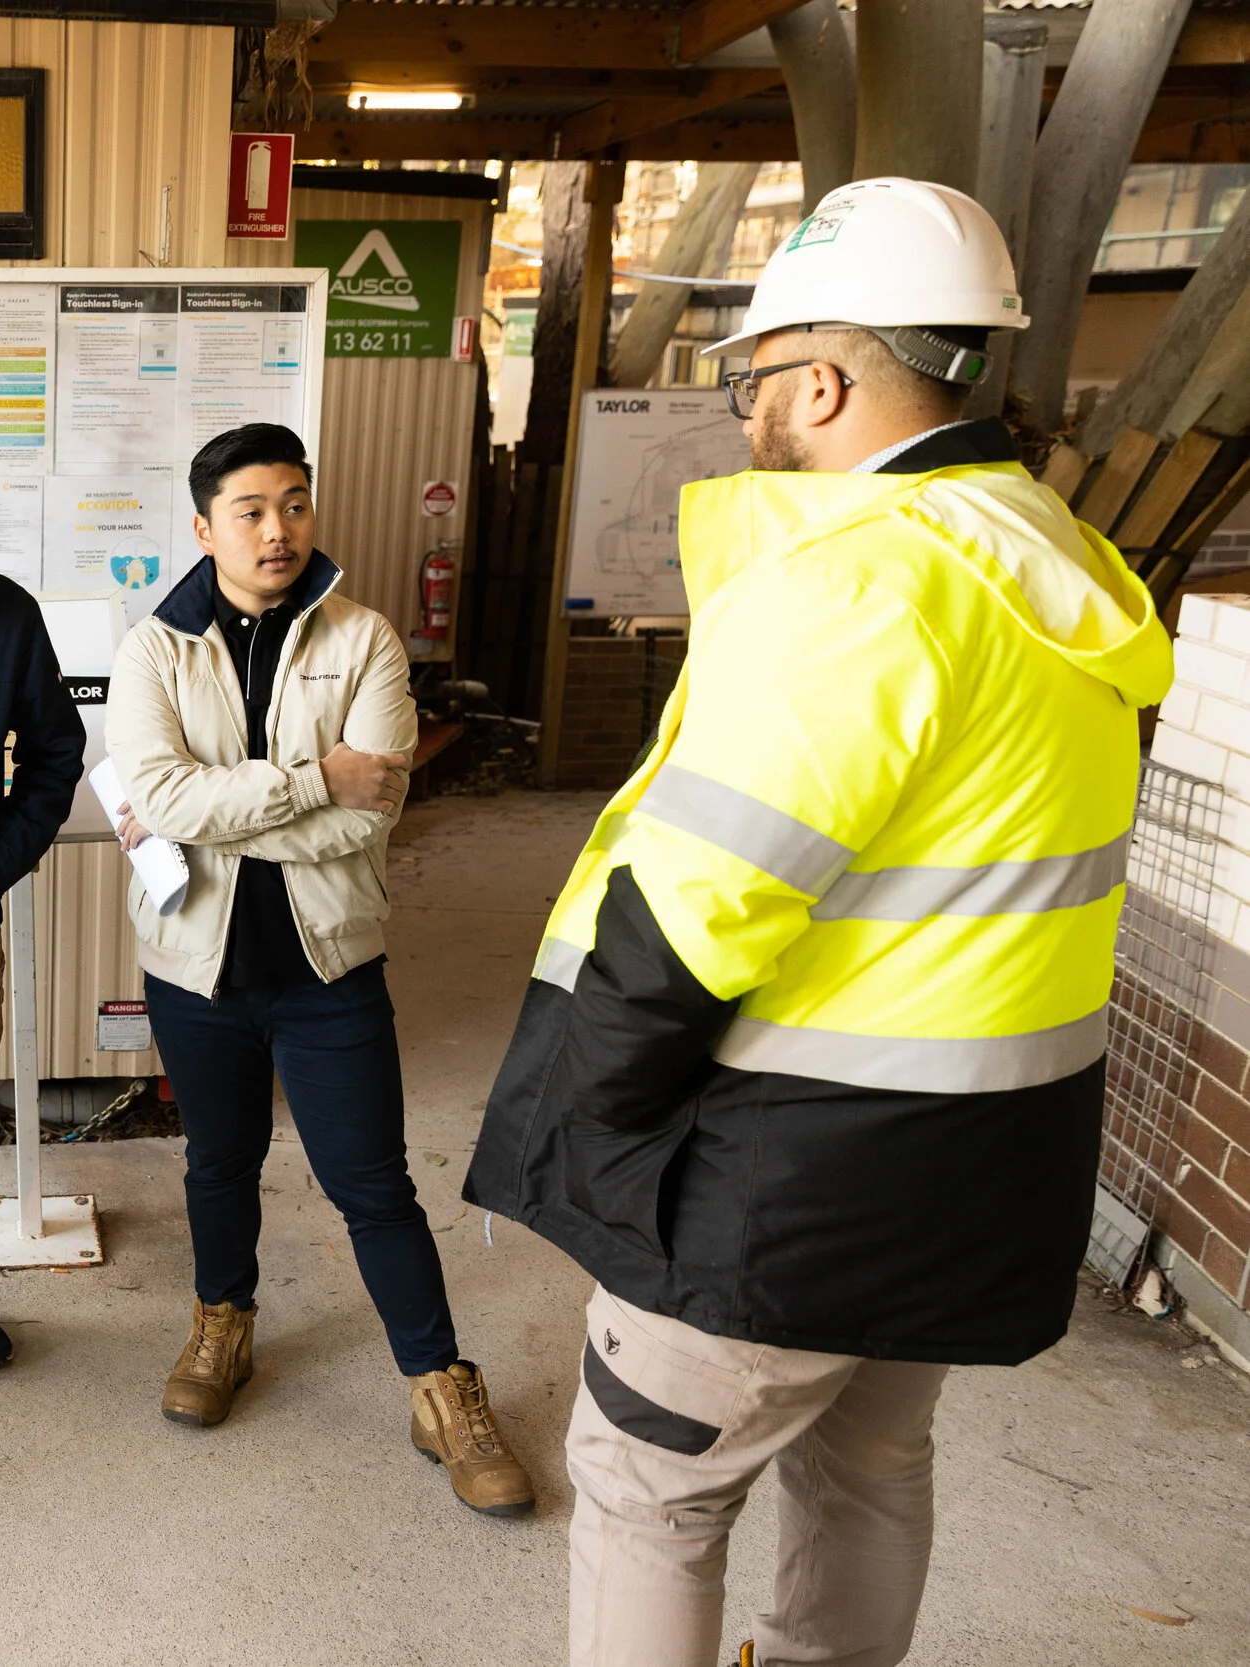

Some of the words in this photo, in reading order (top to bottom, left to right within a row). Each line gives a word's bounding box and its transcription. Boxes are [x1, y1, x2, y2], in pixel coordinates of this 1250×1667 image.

[248, 213, 266, 221] FIRE
[228, 223, 285, 233] EXTINGUISHER
[329, 278, 413, 294] AUSCO
[66, 299, 111, 308] Touchless
[112, 299, 143, 309] Sign-in
[187, 299, 230, 307] Touchless
[231, 299, 262, 308] Sign-in
[333, 332, 355, 351] 13
[360, 332, 385, 351] 62
[391, 332, 411, 351] 11
[596, 399, 651, 413] TAYLOR
[69, 686, 104, 699] LOR
[108, 1004, 144, 1012] DANGER
